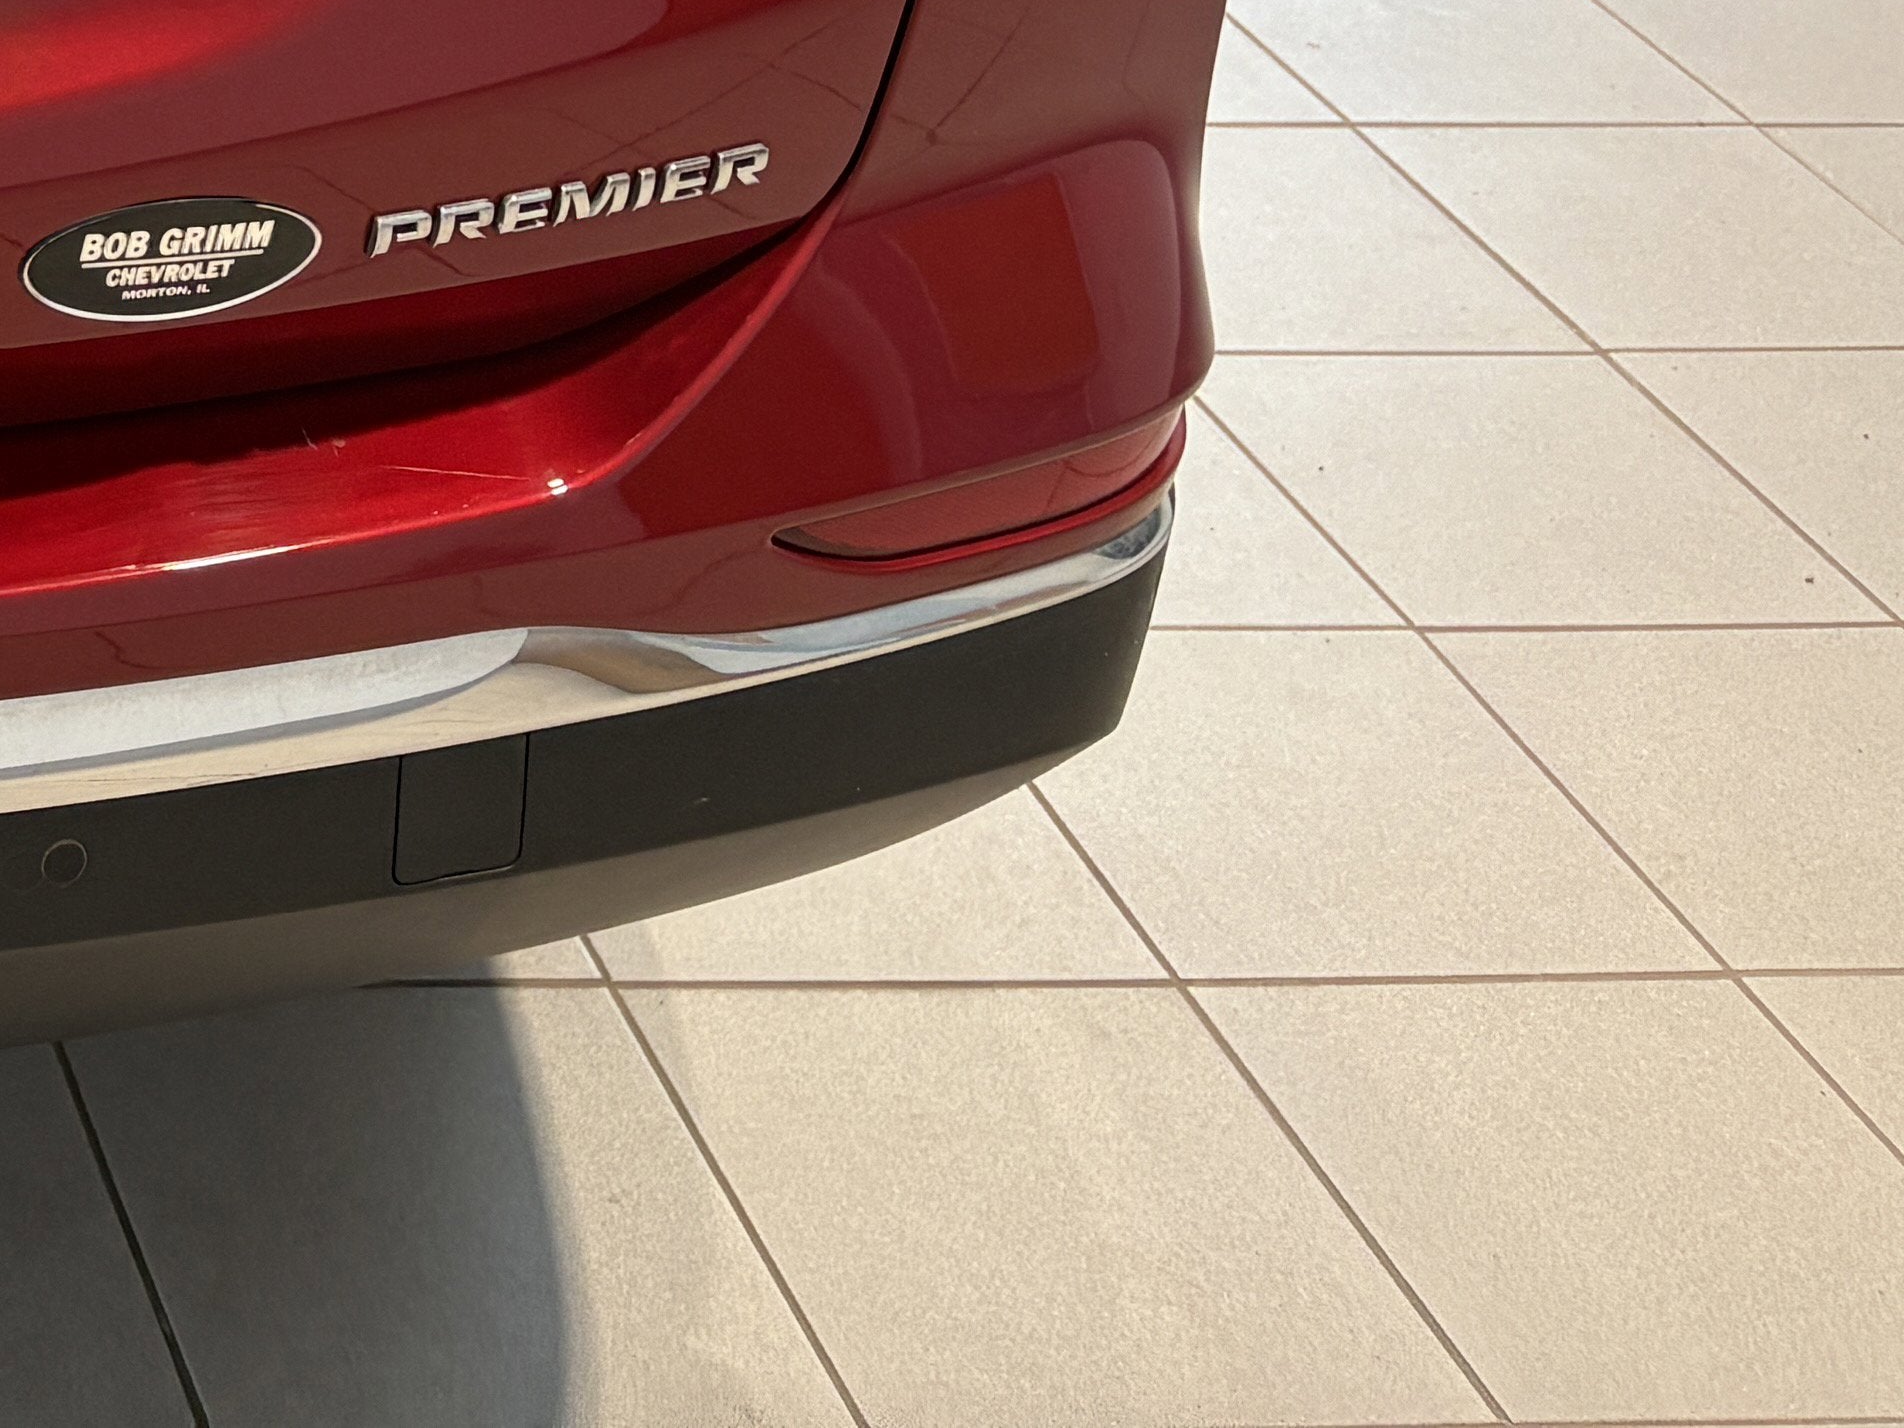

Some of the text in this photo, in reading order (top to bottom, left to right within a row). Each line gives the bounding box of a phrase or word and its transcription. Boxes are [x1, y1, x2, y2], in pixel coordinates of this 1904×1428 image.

[365, 142, 770, 258] PREMIER
[79, 220, 275, 262] BOB GRIMM
[105, 258, 236, 287] CHEVROLET
